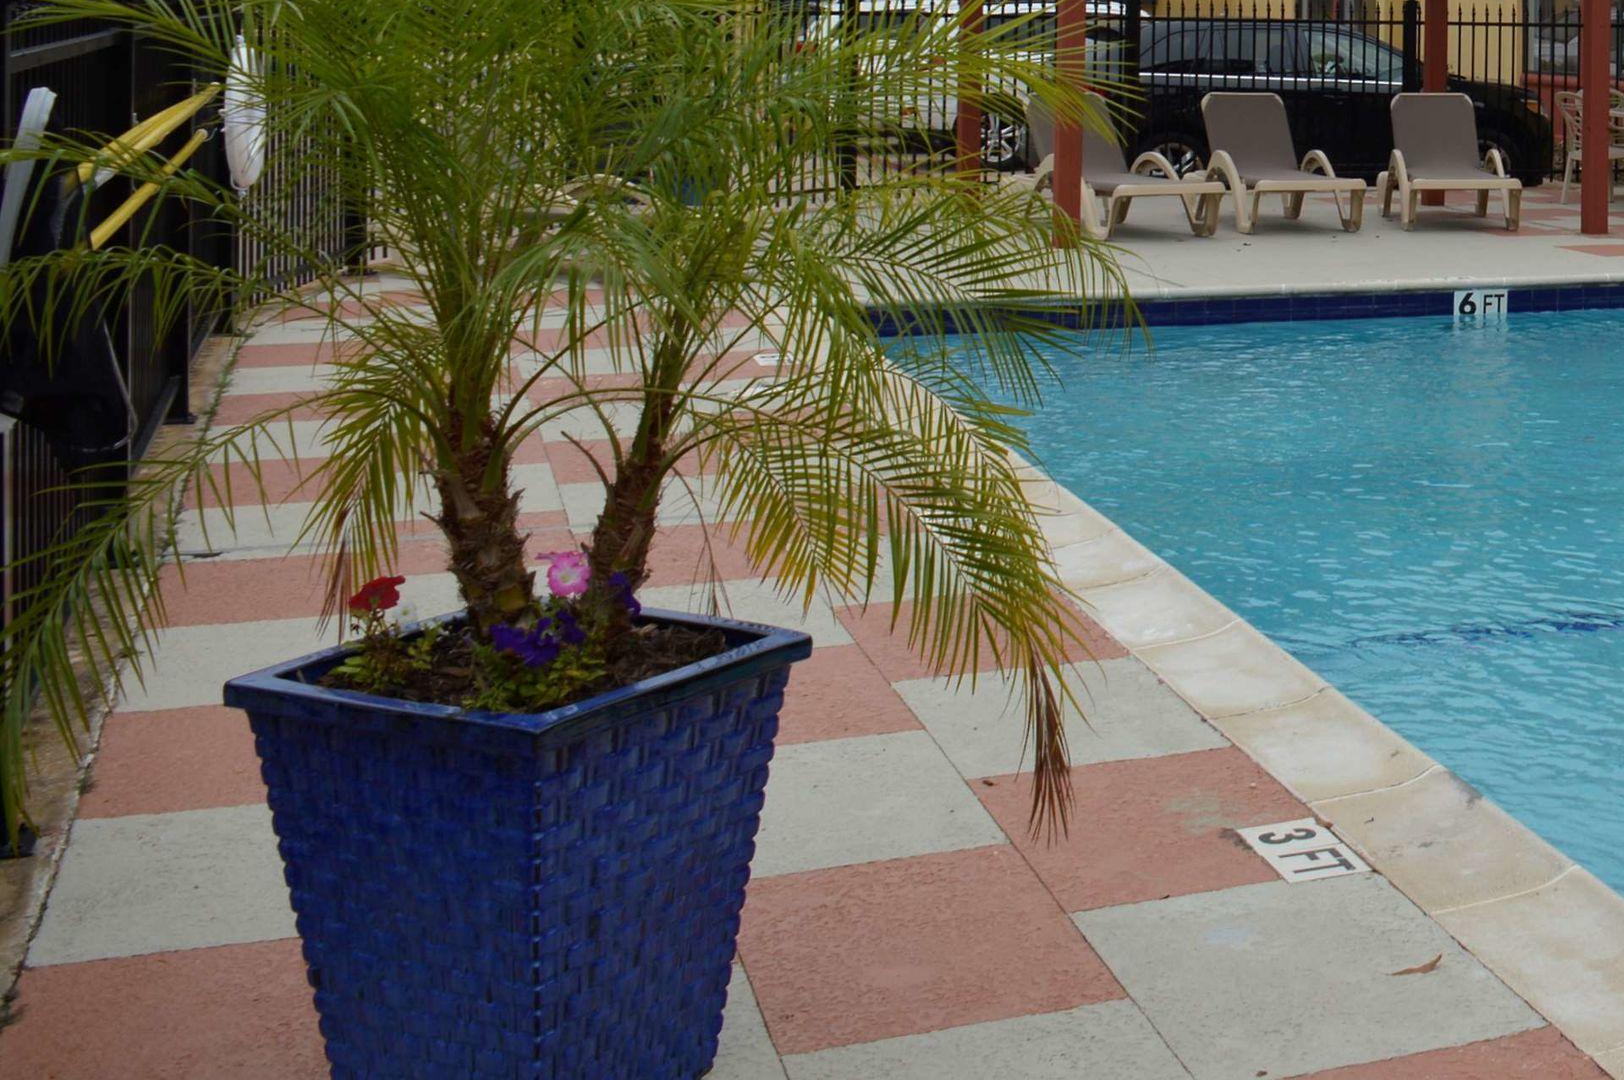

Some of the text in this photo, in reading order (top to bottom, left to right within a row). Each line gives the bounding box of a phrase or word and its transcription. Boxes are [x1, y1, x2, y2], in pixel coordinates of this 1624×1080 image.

[1459, 292, 1505, 315] 6 FT
[1258, 827, 1357, 874] 3 FT
